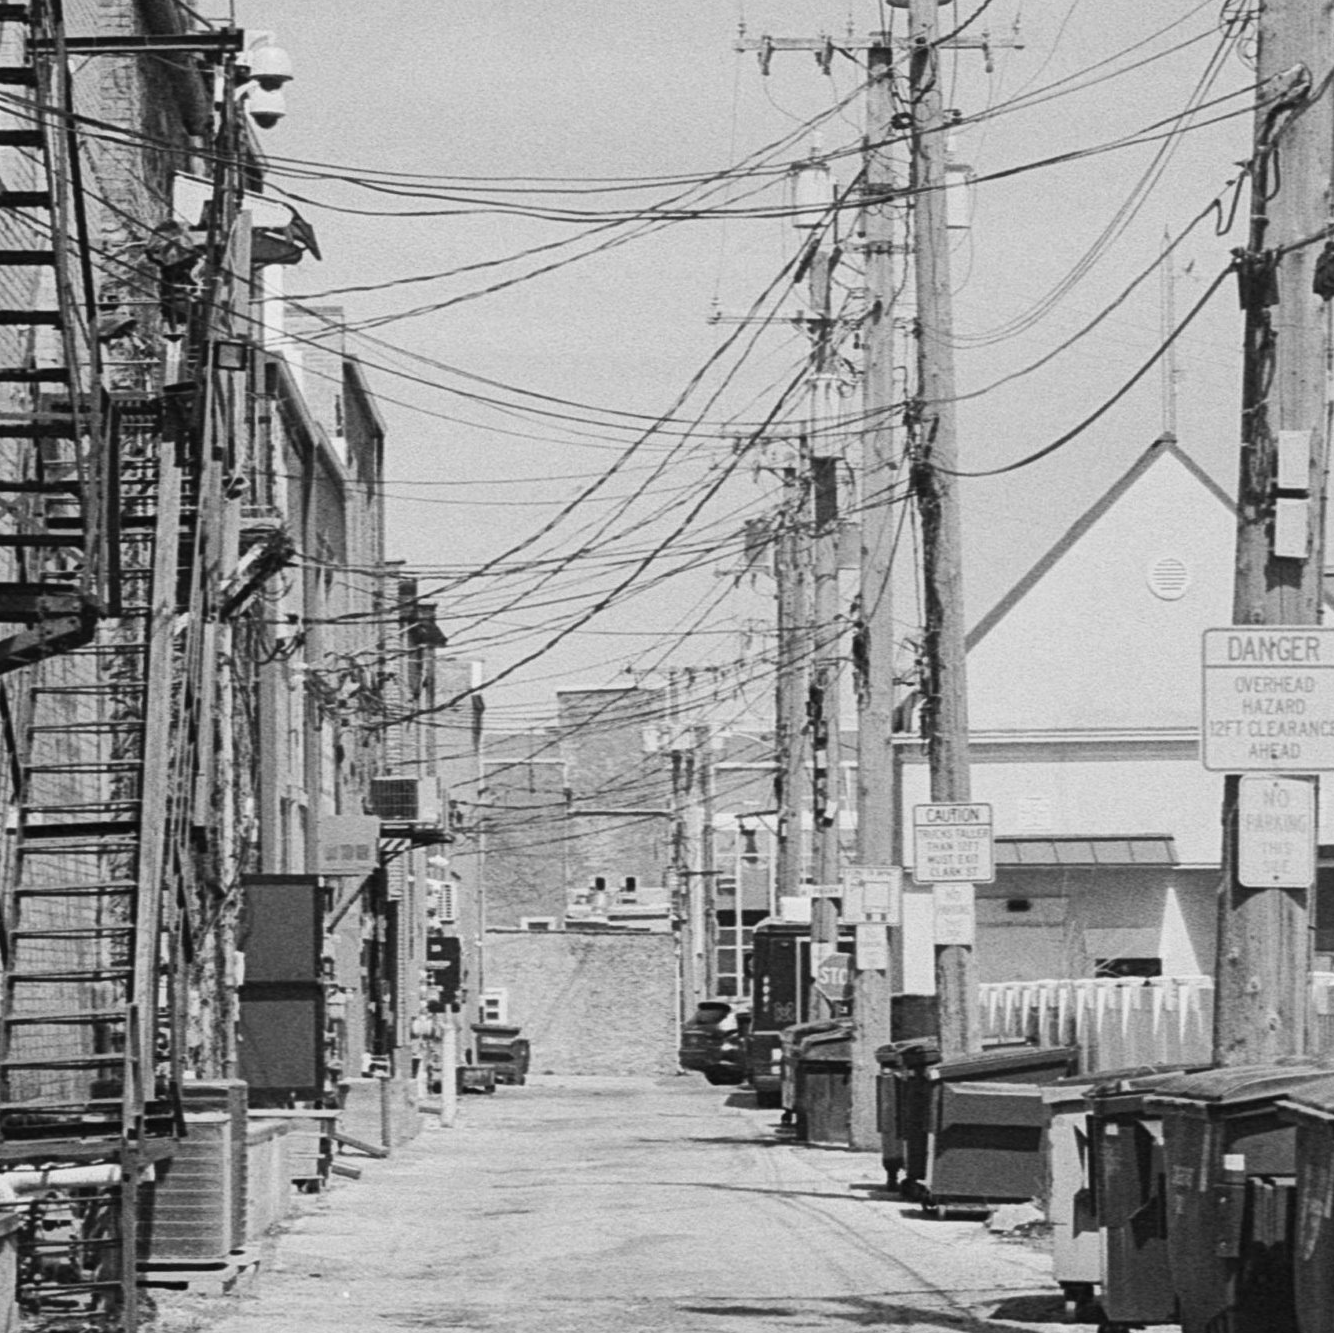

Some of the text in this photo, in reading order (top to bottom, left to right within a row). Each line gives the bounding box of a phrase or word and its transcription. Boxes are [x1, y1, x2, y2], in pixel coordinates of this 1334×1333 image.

[1228, 636, 1320, 662] DANGER
[1234, 676, 1316, 693] OVERHEAD
[1242, 698, 1306, 716] HAZARD
[1210, 720, 1244, 737] 12FT
[1248, 742, 1302, 759] AHEAD
[926, 808, 980, 823] CAUTION
[817, 967, 849, 985] STO
